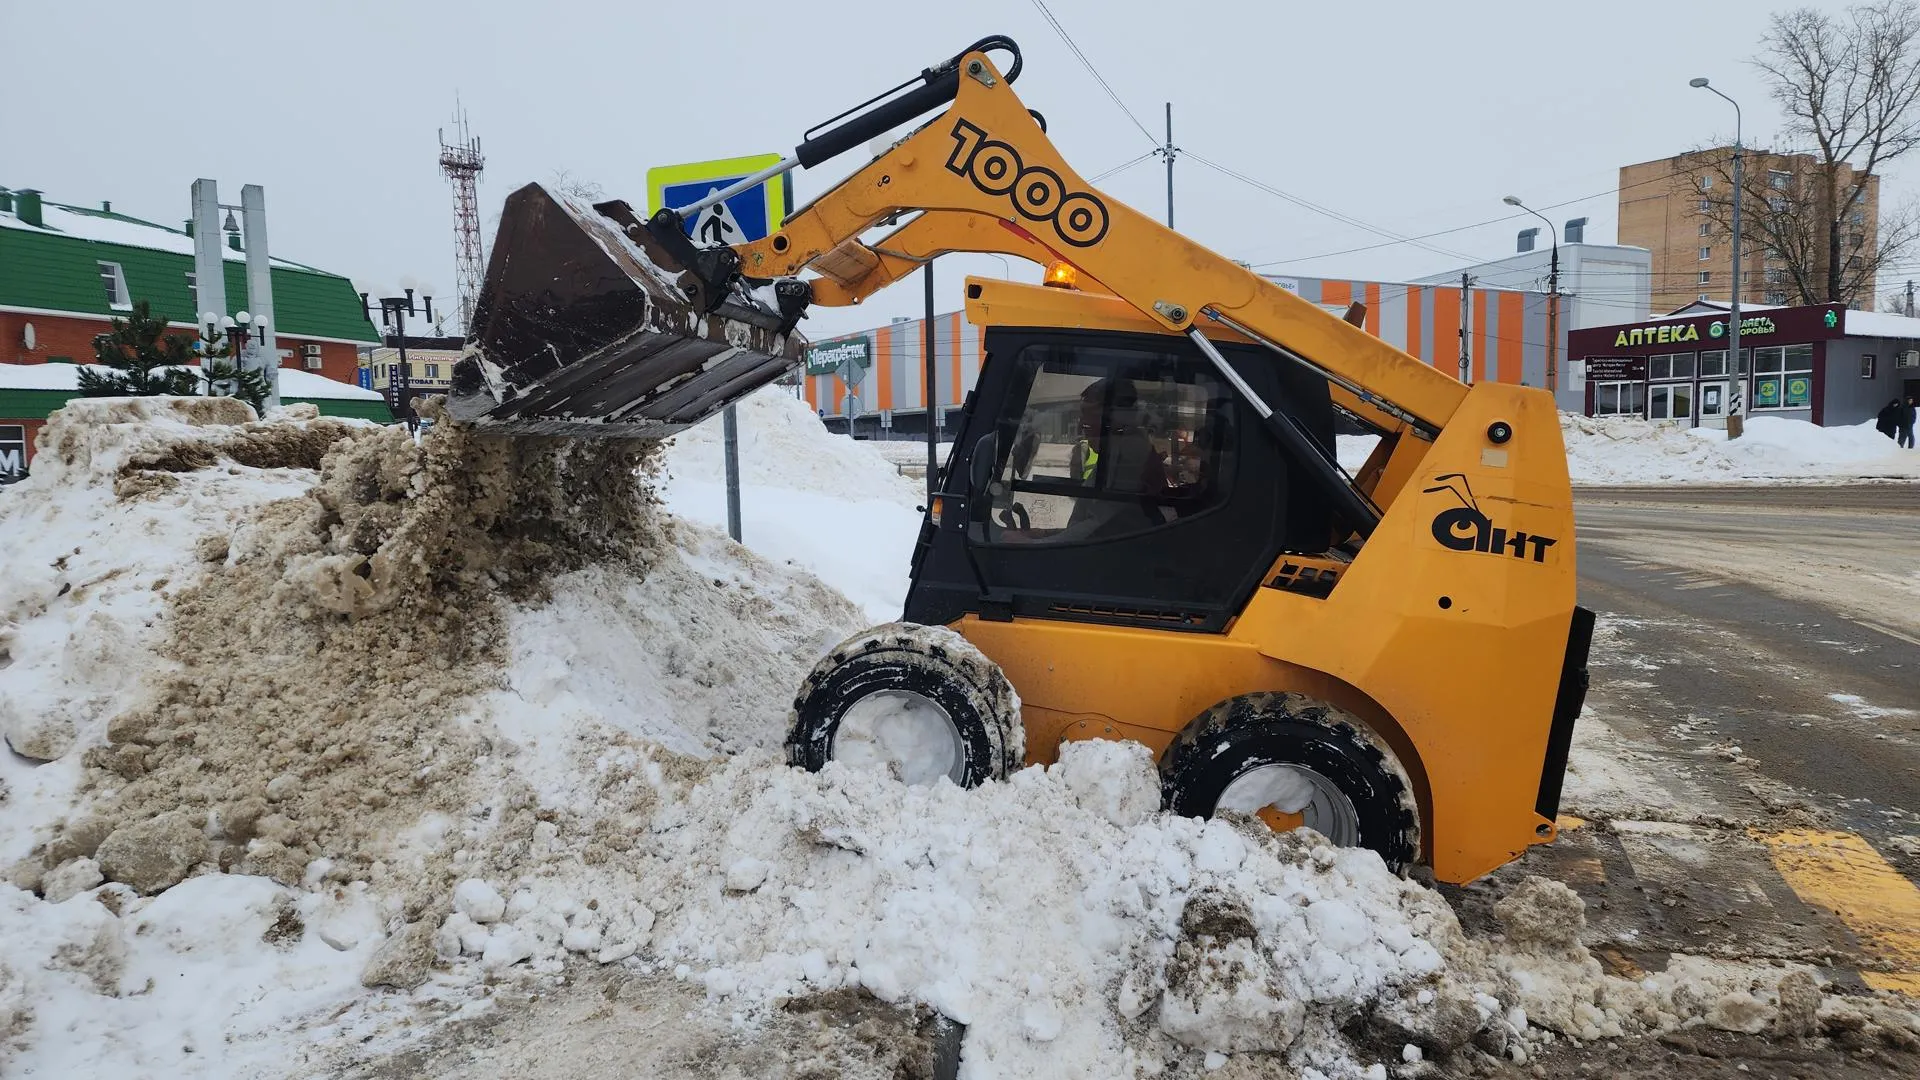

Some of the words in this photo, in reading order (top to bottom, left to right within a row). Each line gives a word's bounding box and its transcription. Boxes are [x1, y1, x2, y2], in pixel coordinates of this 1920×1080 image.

[945, 117, 1109, 247] 1000
[1614, 323, 1699, 347] АПТЕКА
[391, 365, 399, 407] ТЕХНОМИР
